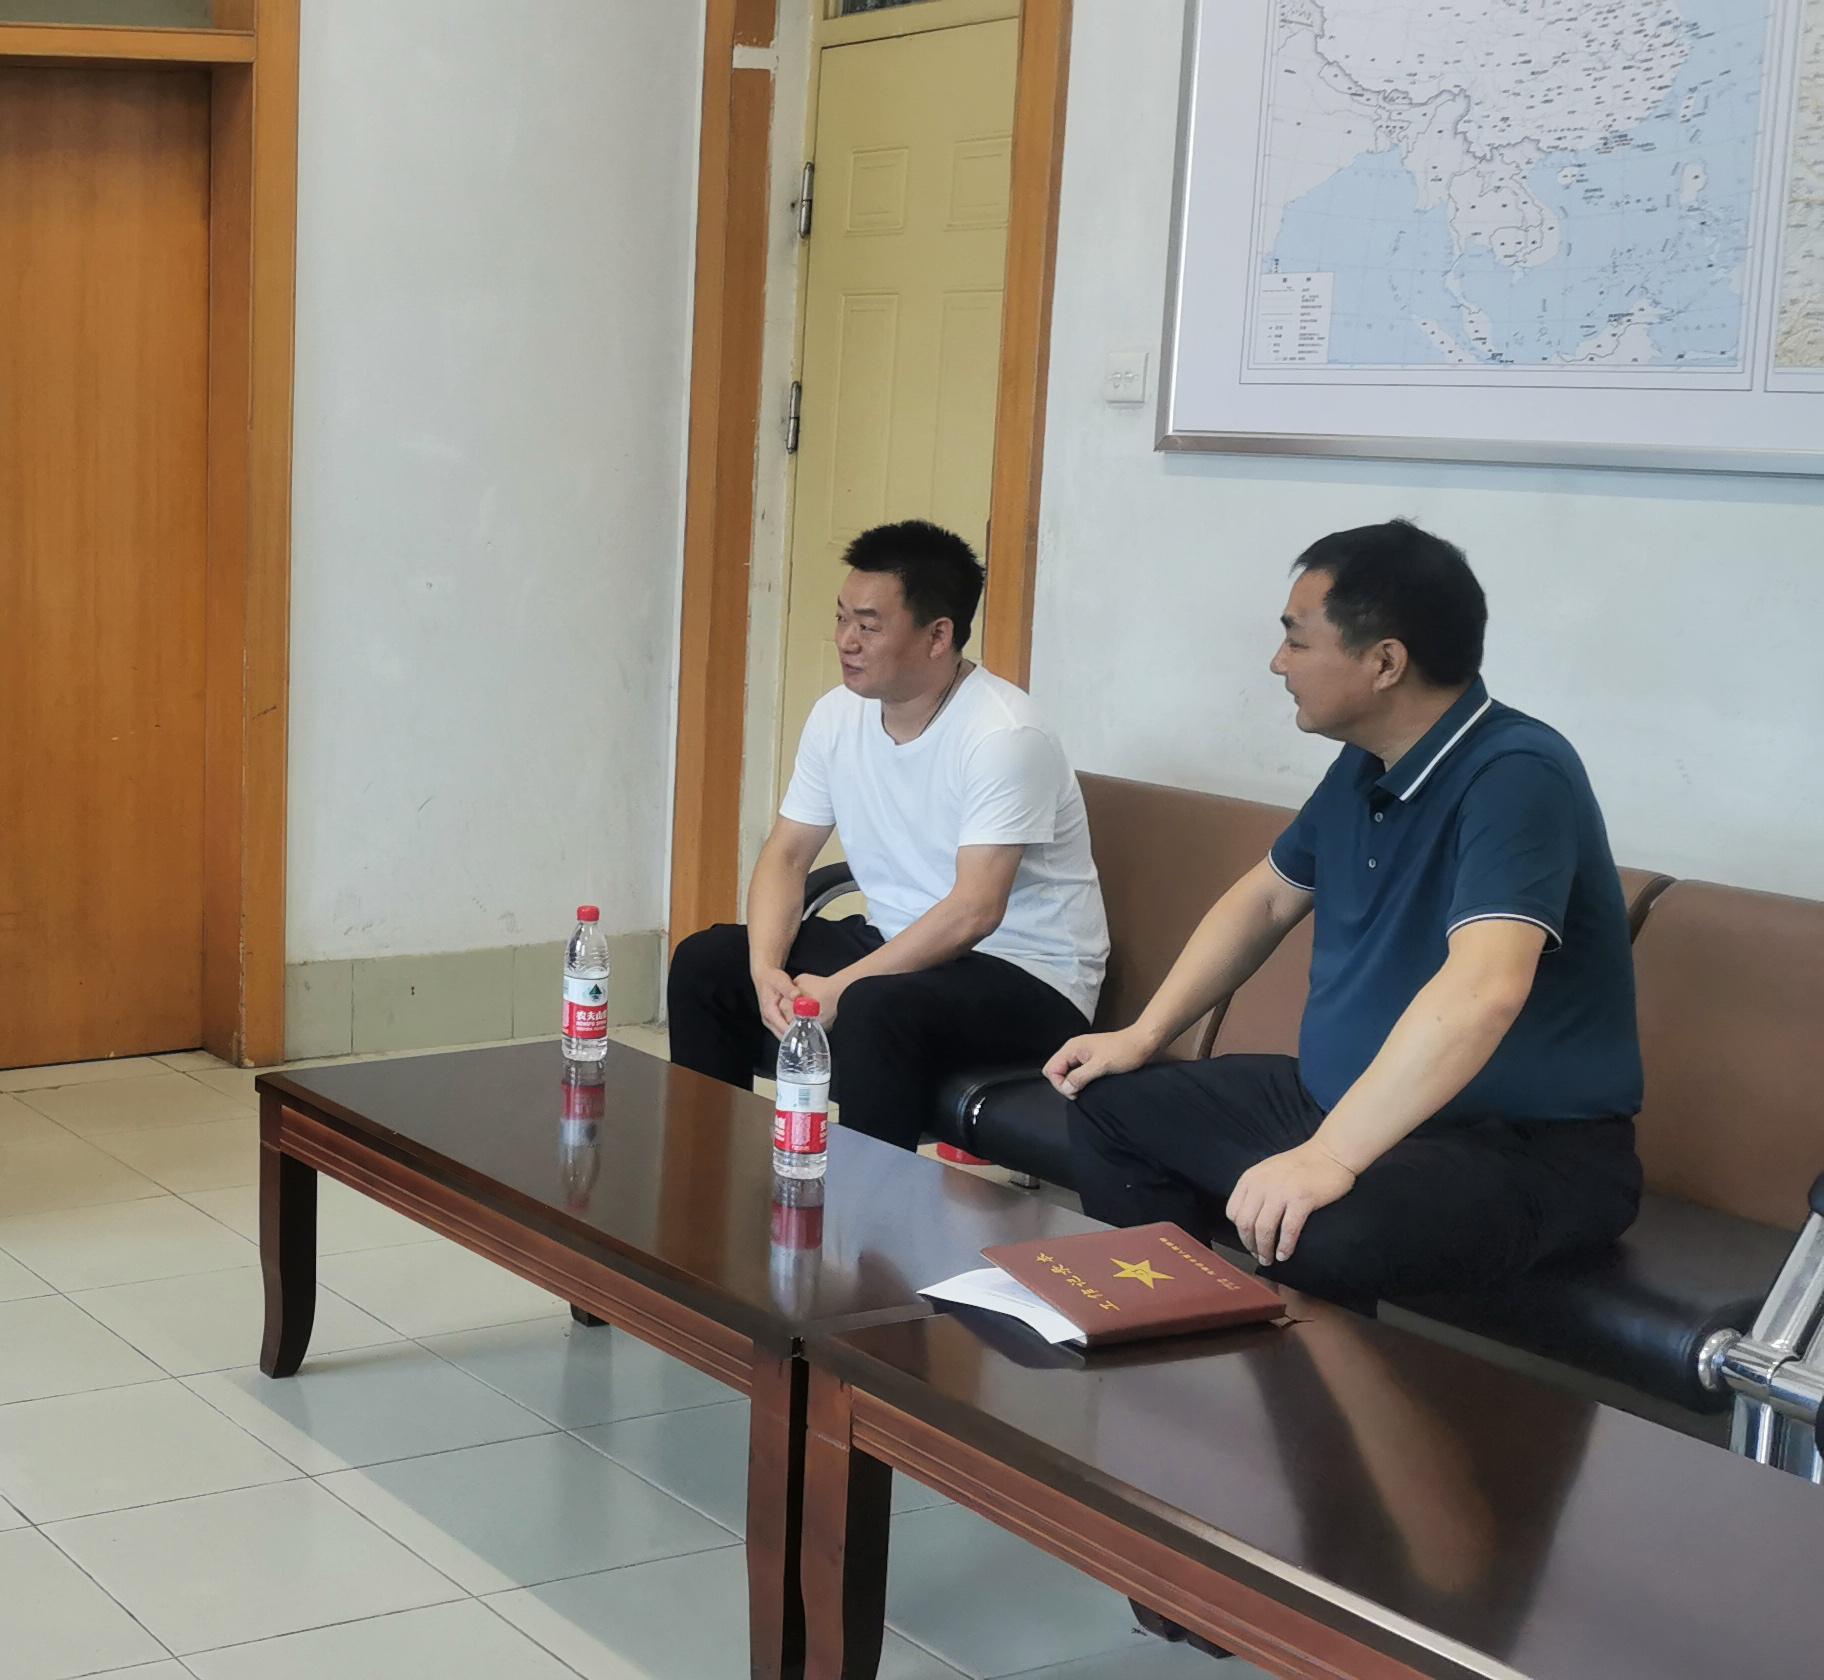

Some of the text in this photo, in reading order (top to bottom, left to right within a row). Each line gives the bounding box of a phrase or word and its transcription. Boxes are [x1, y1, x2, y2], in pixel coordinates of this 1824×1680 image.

[1035, 1252, 1120, 1311] 工作记录本
